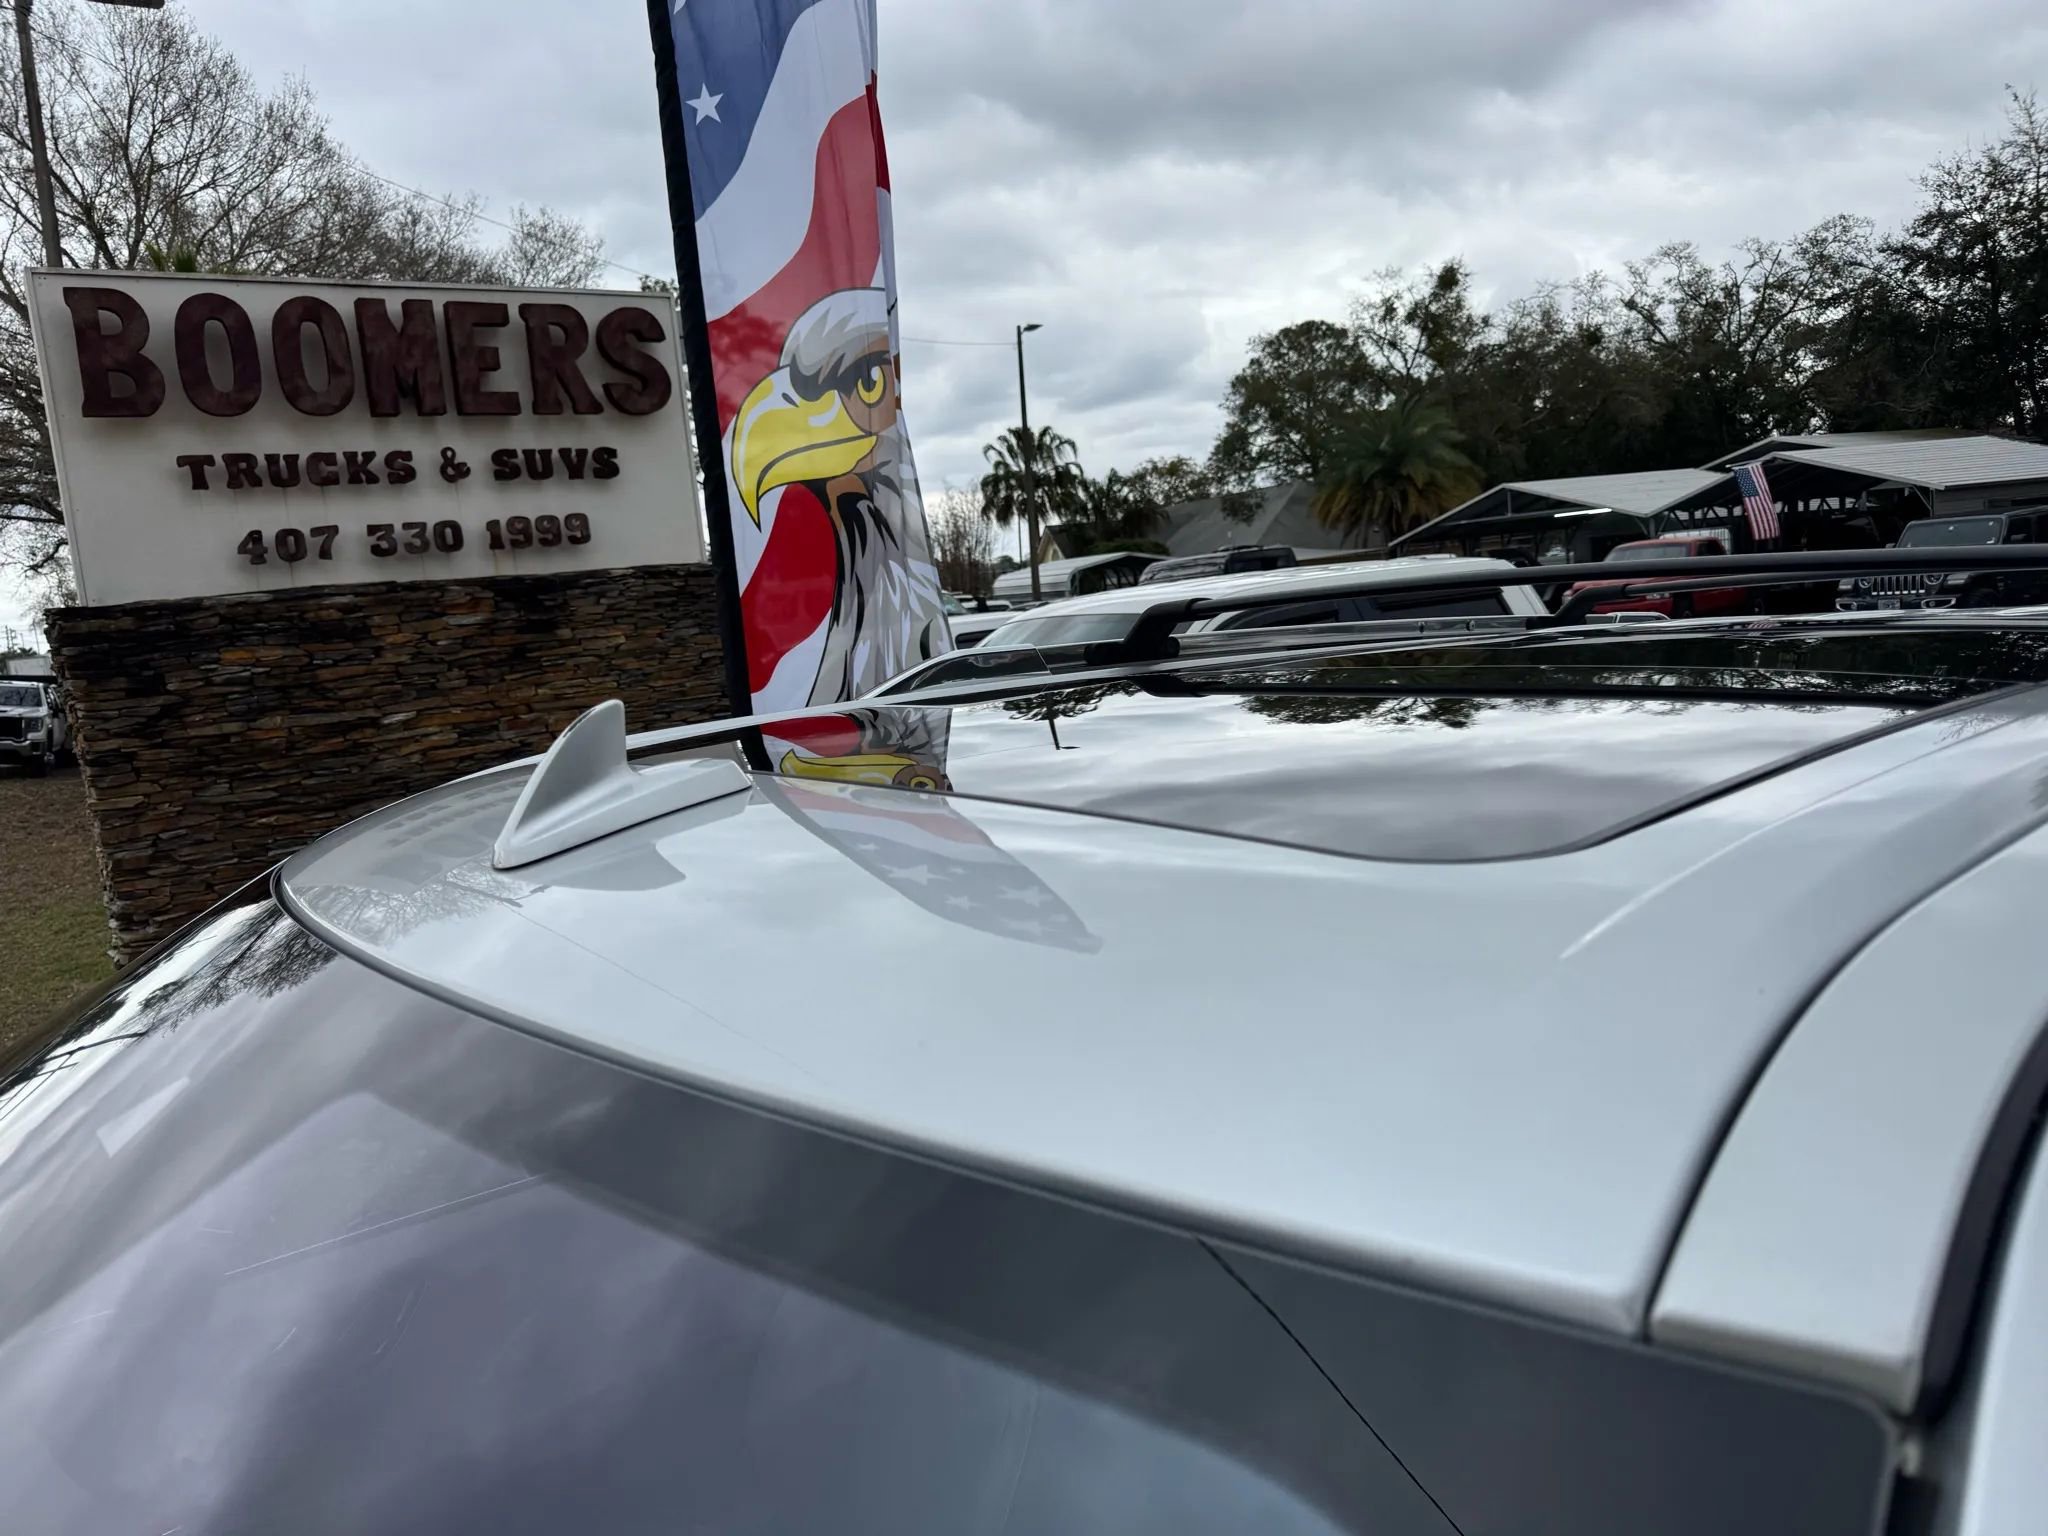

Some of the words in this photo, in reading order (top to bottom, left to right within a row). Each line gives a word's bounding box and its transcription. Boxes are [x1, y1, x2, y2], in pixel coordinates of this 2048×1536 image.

[62, 286, 673, 418] BOOMERS
[176, 449, 418, 490] TRUCKS
[439, 446, 471, 483] &
[491, 446, 621, 481] SUVS
[236, 525, 340, 565] 407
[366, 519, 464, 557] 330
[485, 512, 592, 551] 1999
